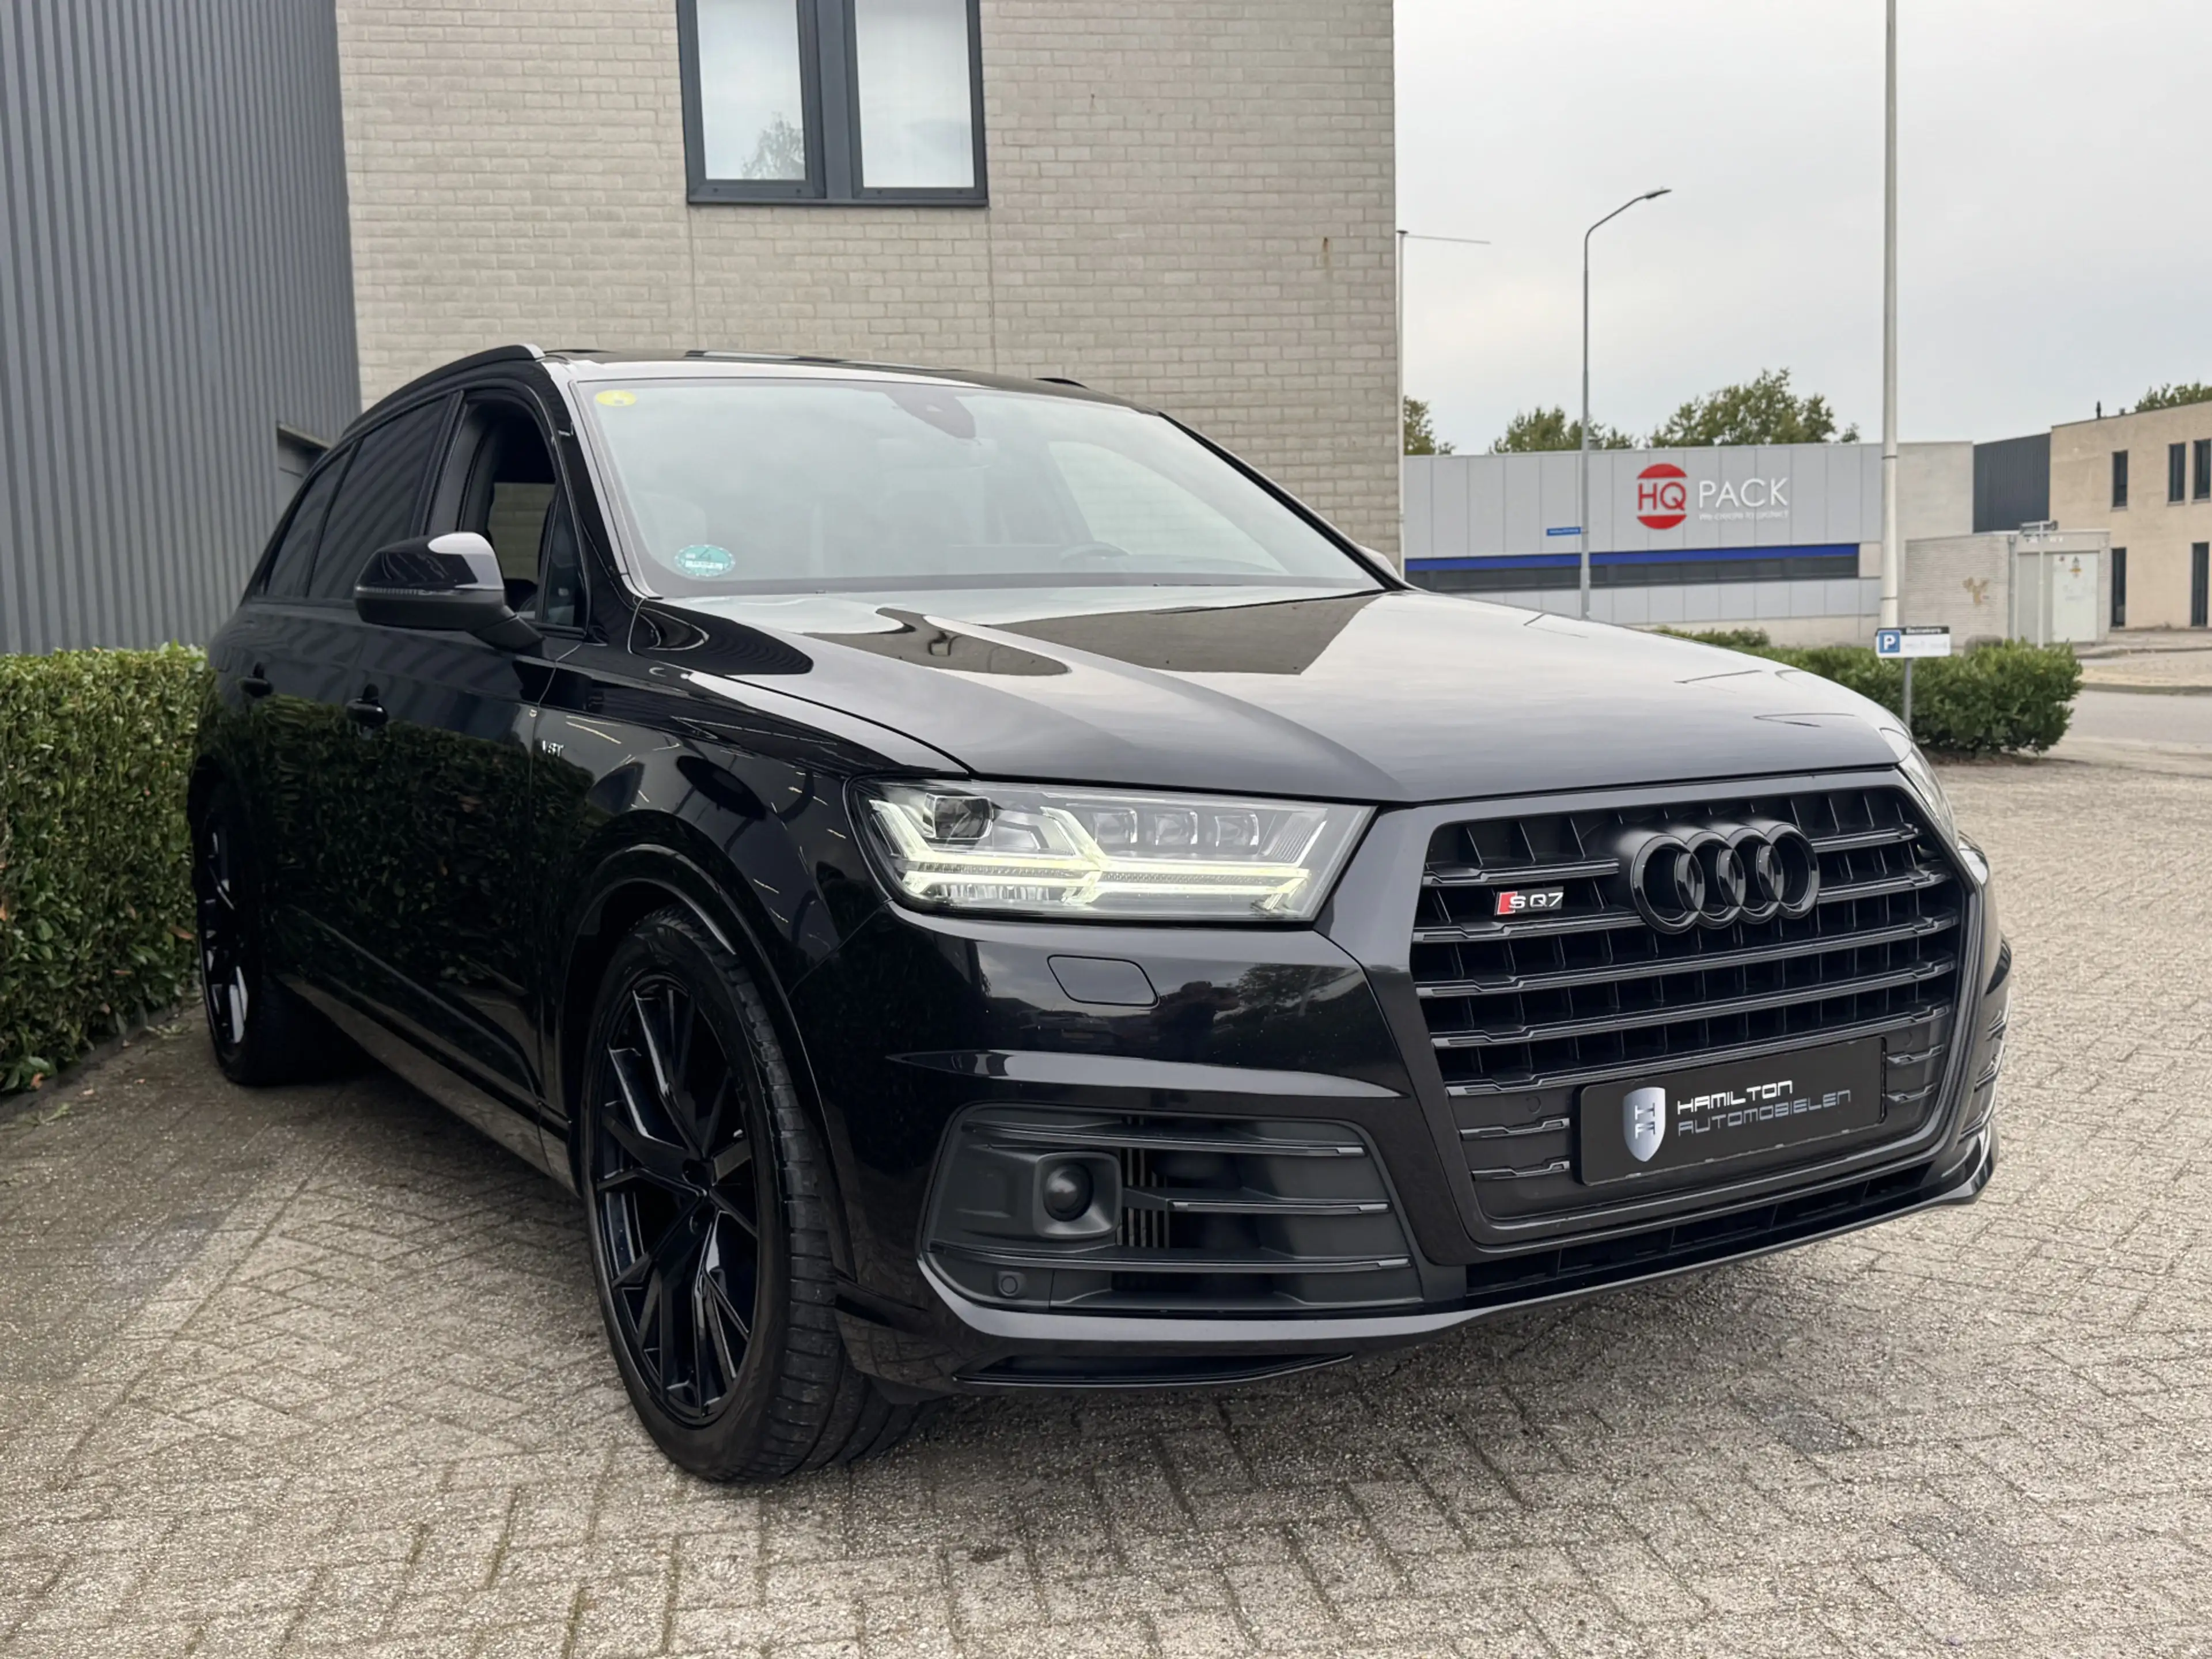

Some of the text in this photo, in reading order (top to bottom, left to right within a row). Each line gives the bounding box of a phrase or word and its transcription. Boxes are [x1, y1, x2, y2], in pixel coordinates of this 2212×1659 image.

[1637, 478, 1788, 511] HQ PACK
[1509, 892, 1563, 908] SQ7
[1677, 1080, 1793, 1115] HAMILTON
[1677, 1089, 1851, 1137] AUTOMOBIELEN
